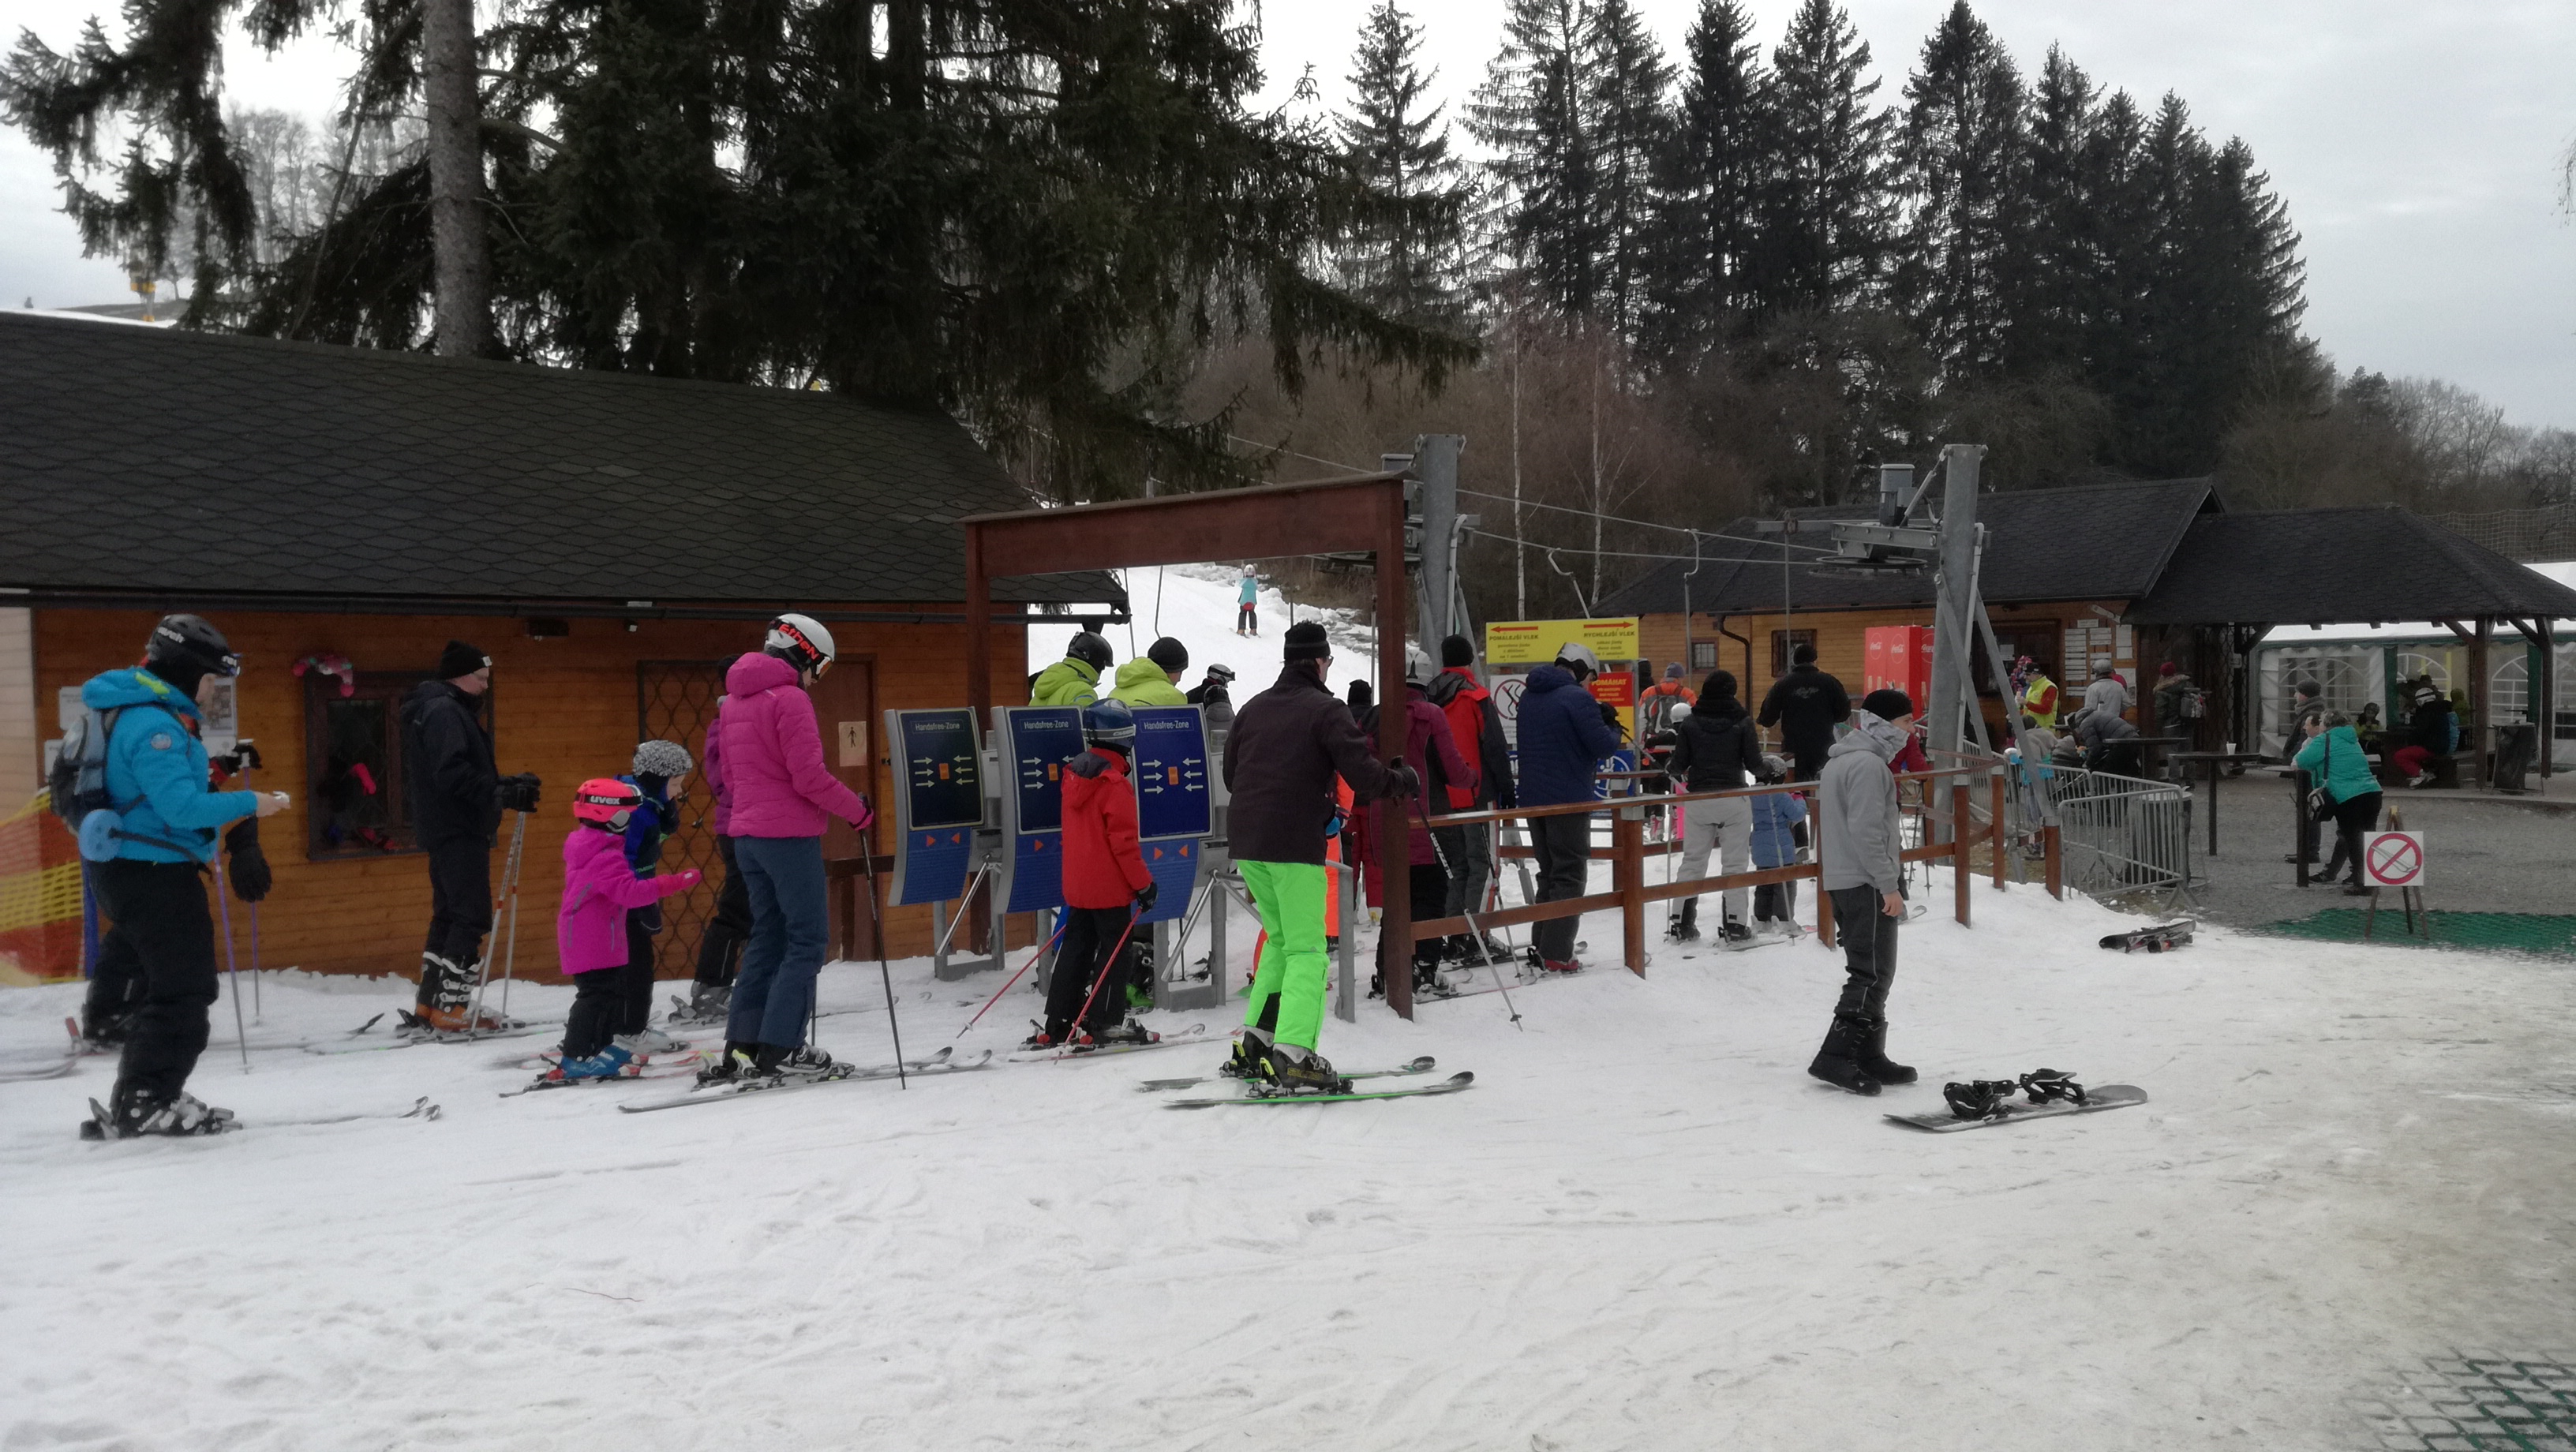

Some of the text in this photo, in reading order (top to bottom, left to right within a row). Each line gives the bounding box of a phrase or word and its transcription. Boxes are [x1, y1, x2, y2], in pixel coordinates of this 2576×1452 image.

[915, 721, 960, 731] Handsfree-Zone
[1024, 720, 1069, 729] Handsfree-Zone
[1144, 720, 1189, 730] Handsfree-Zone
[590, 795, 620, 805] uvex
